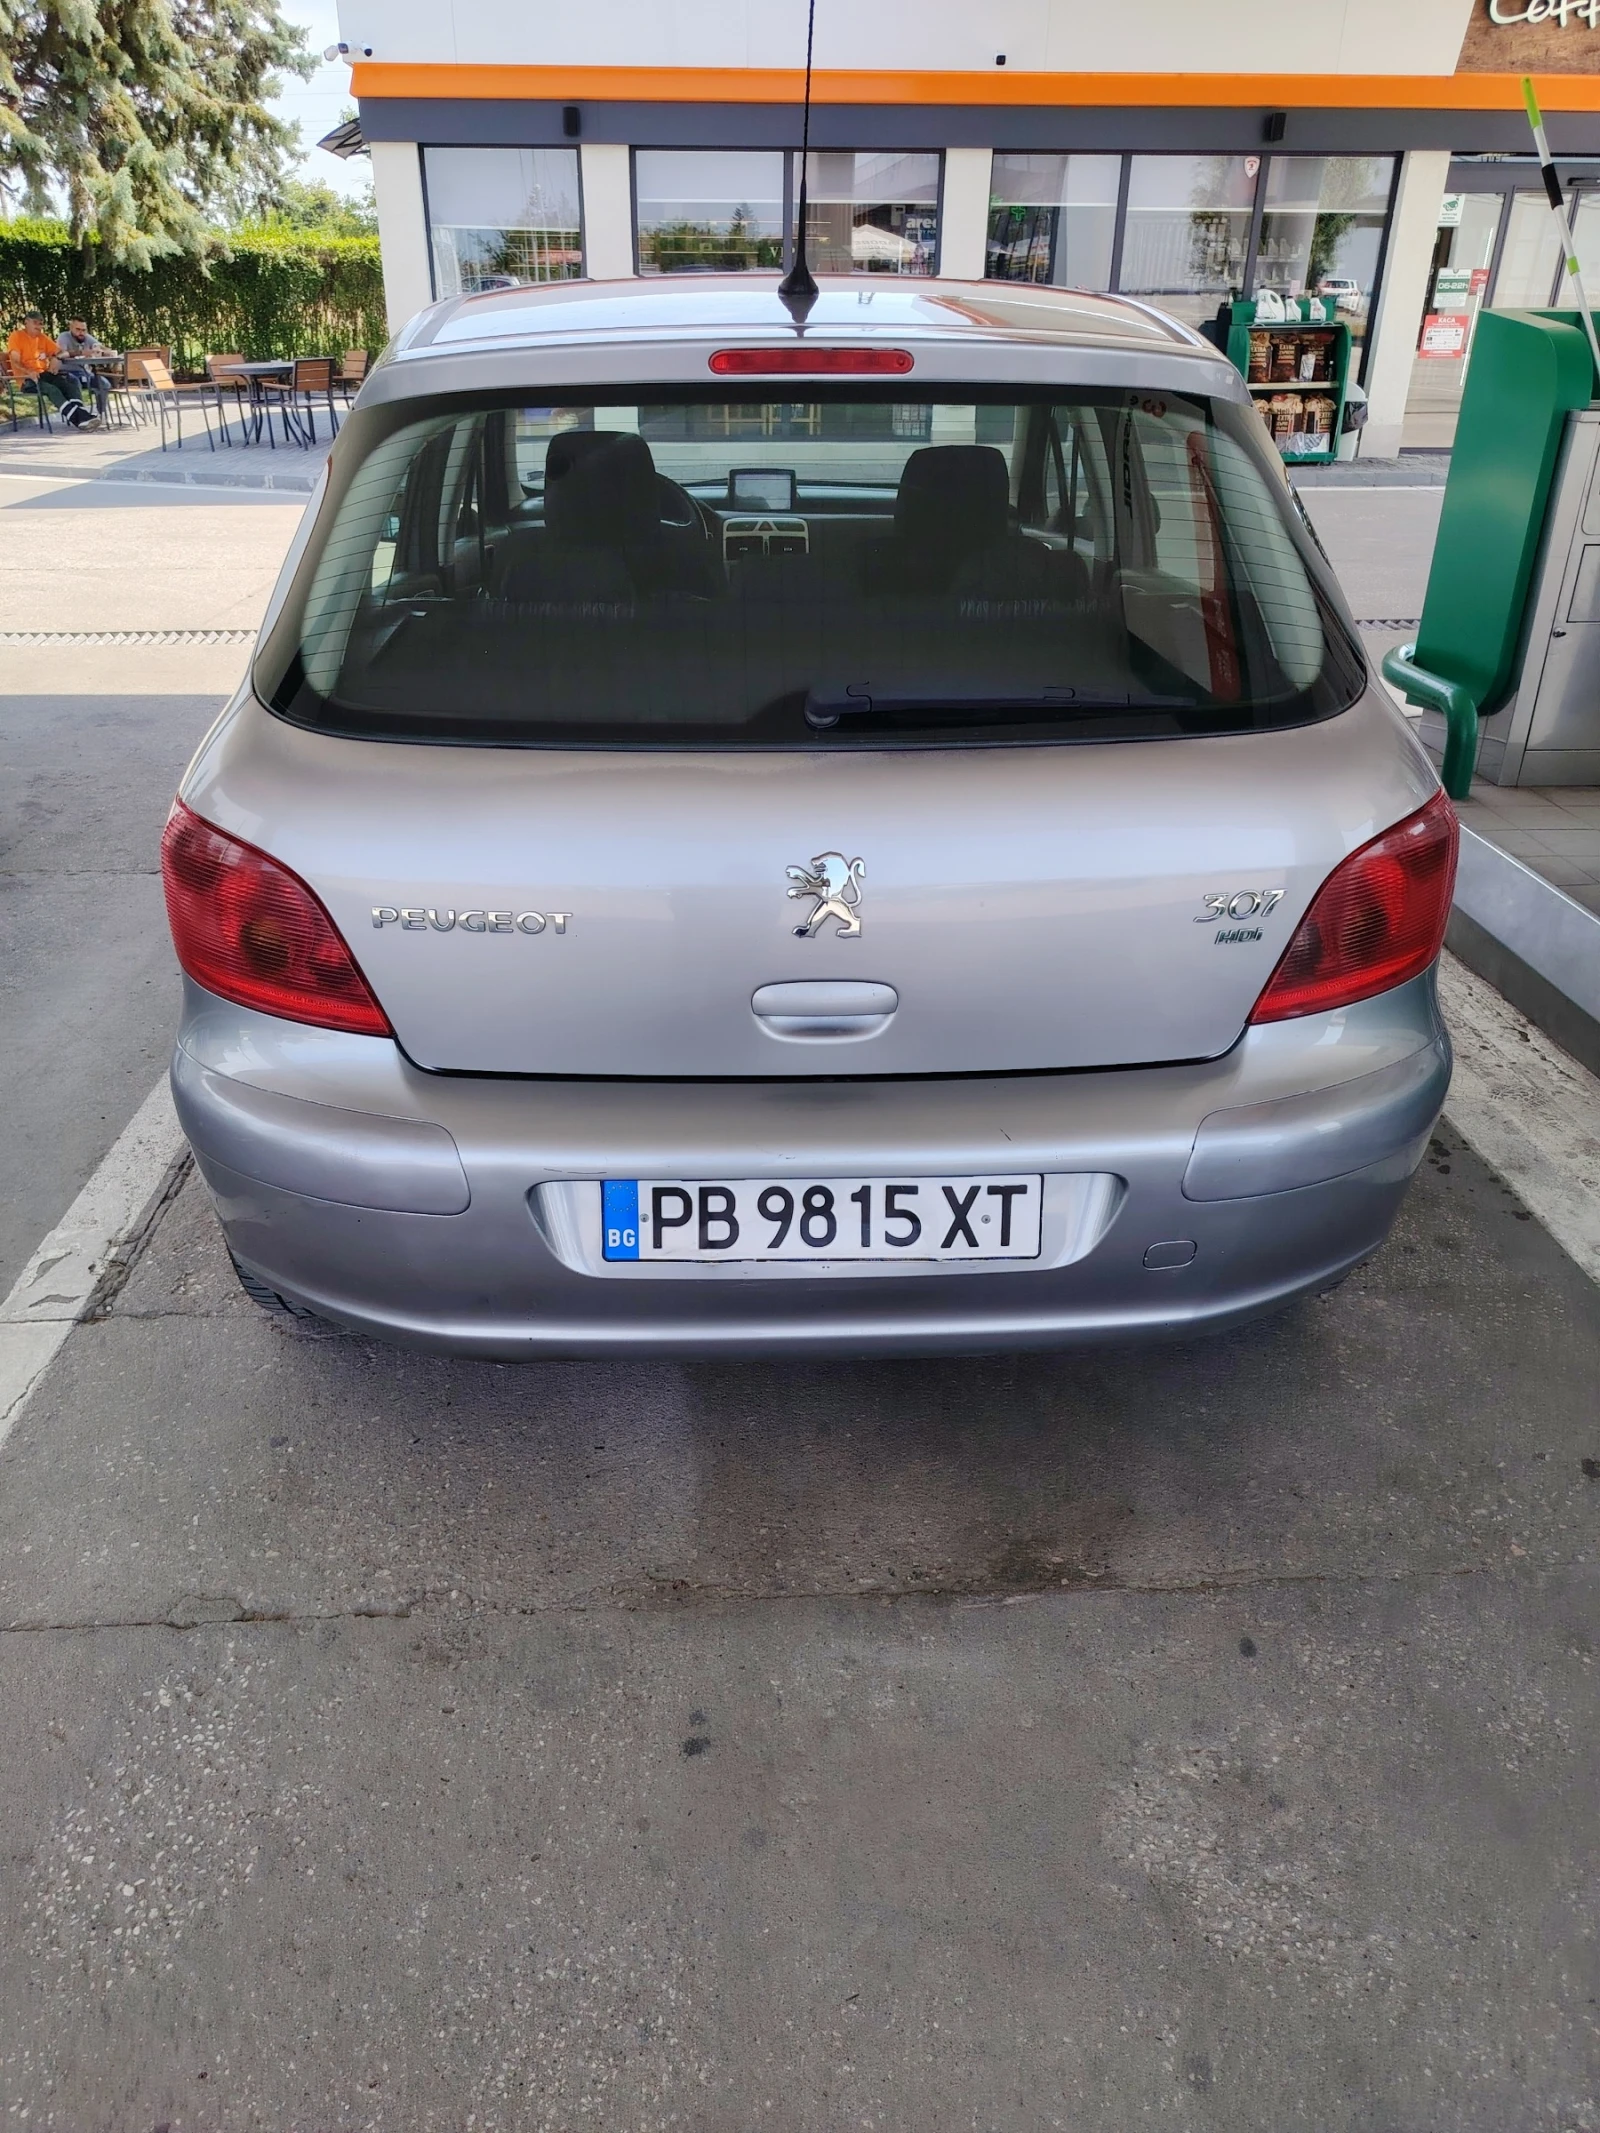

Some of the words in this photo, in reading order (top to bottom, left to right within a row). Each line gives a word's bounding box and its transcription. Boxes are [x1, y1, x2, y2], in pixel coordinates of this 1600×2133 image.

[371, 906, 573, 934] PEUGEOT
[1193, 888, 1288, 923] 307
[651, 1186, 740, 1250] PB
[757, 1185, 922, 1249] 9815
[940, 1184, 1028, 1249] XT
[608, 1228, 636, 1247] BG
